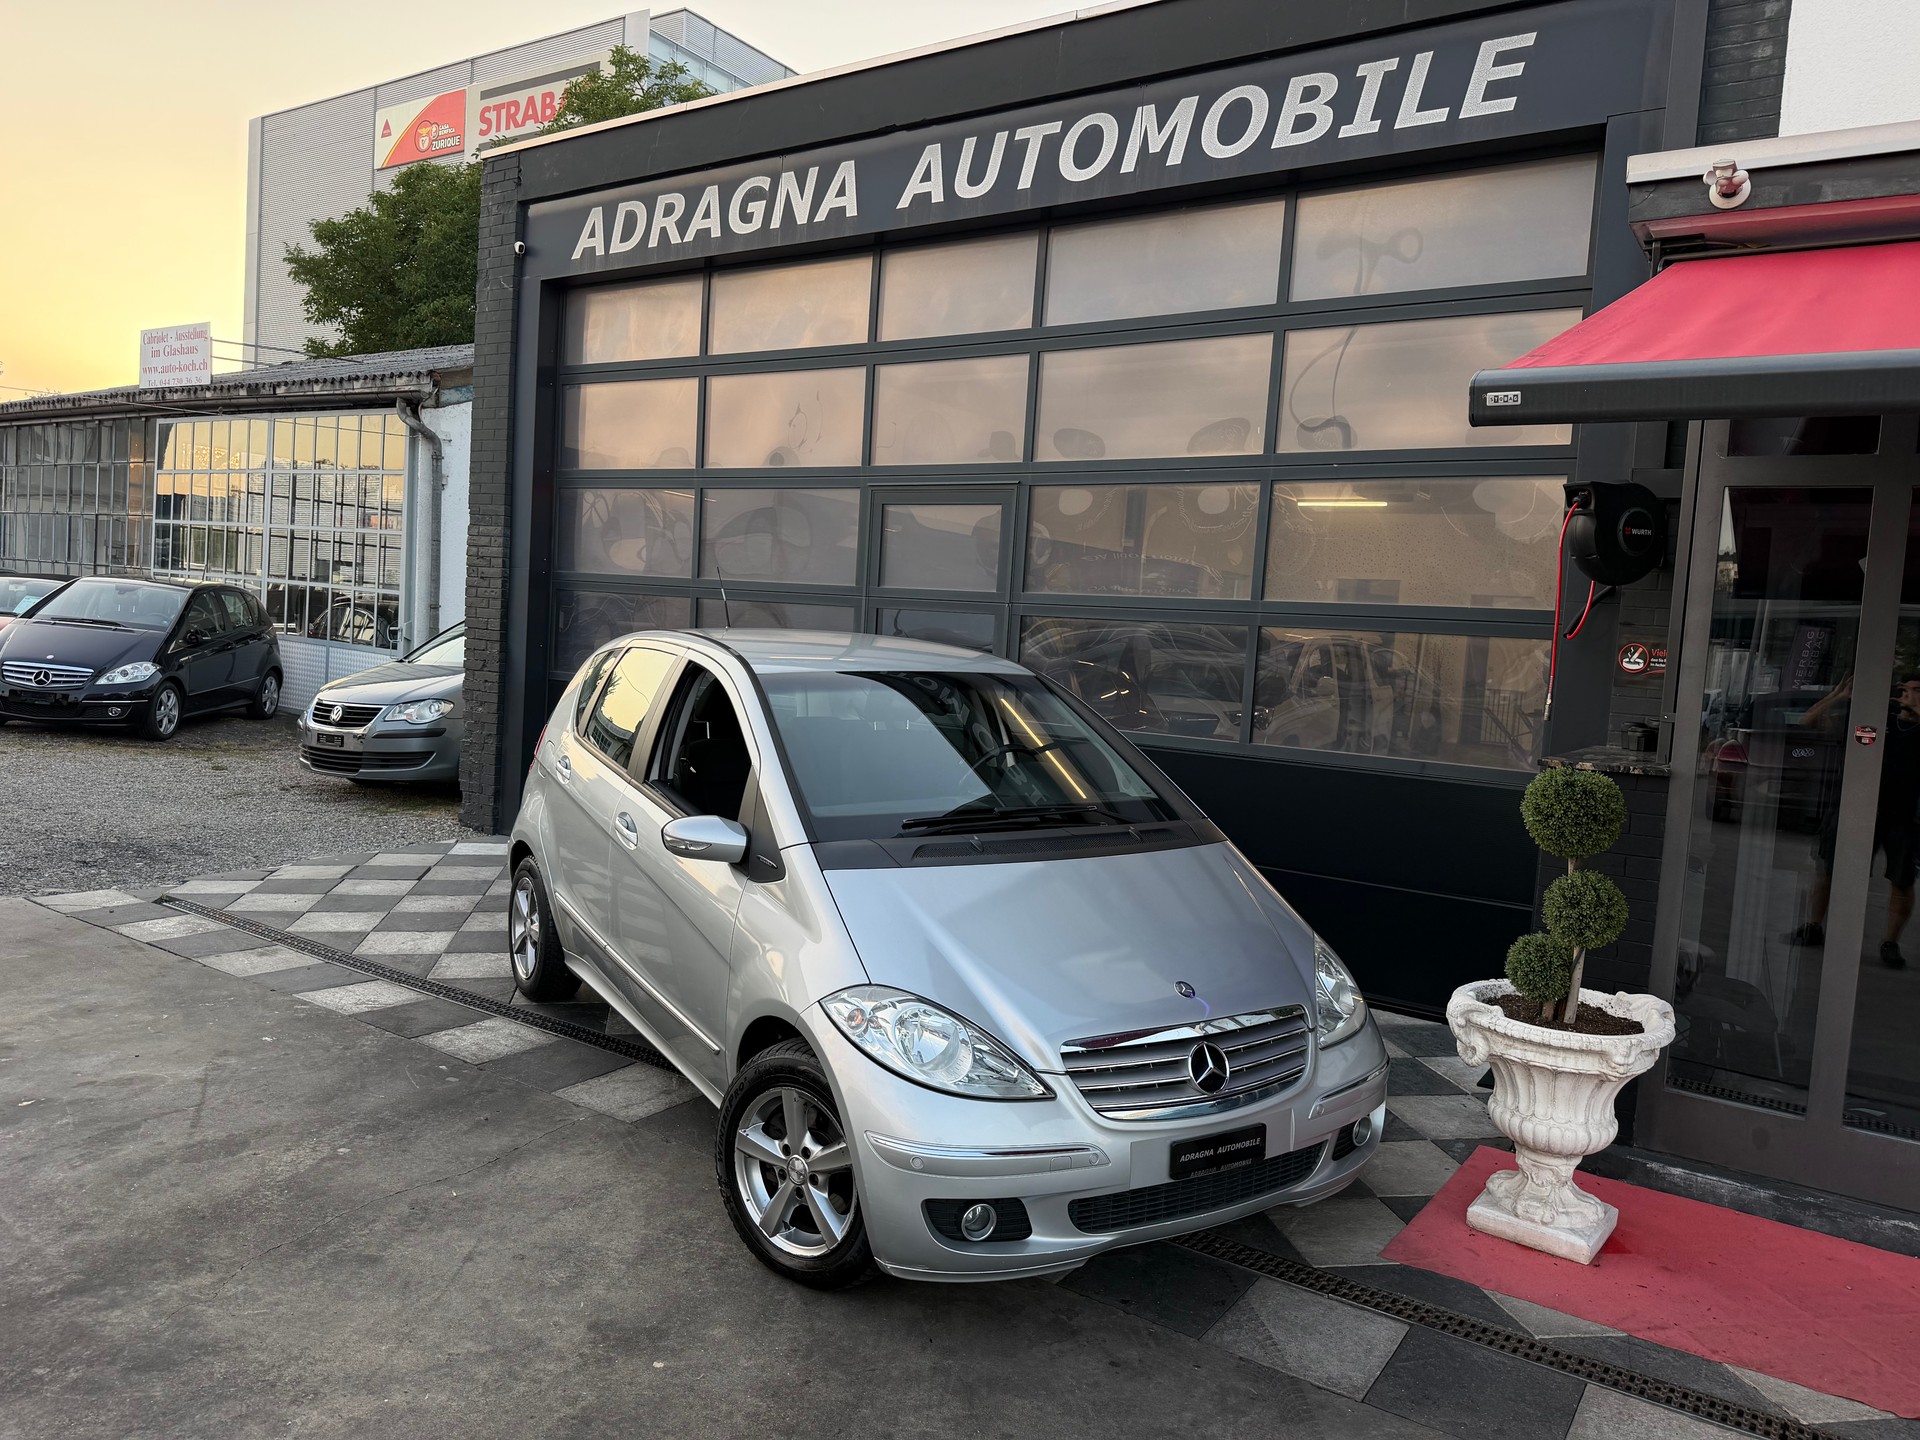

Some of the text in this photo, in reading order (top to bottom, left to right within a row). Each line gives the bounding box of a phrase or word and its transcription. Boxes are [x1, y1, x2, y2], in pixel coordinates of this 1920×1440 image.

[479, 88, 567, 136] STRAB
[439, 128, 455, 136] BENFICA
[432, 136, 460, 151] ZURIQUE
[571, 32, 1538, 260] ADRAGNA AUTOMOBILE
[143, 331, 169, 345] Cabriolet
[175, 327, 208, 341] Ausstellung
[151, 344, 199, 358] im Glashaus
[142, 359, 208, 375] www.auto-koch.ch
[148, 379, 158, 387] Tel.
[1490, 395, 1518, 403] STOBAG
[1179, 1137, 1261, 1162] ADRAGNA AUTOMOBILE
